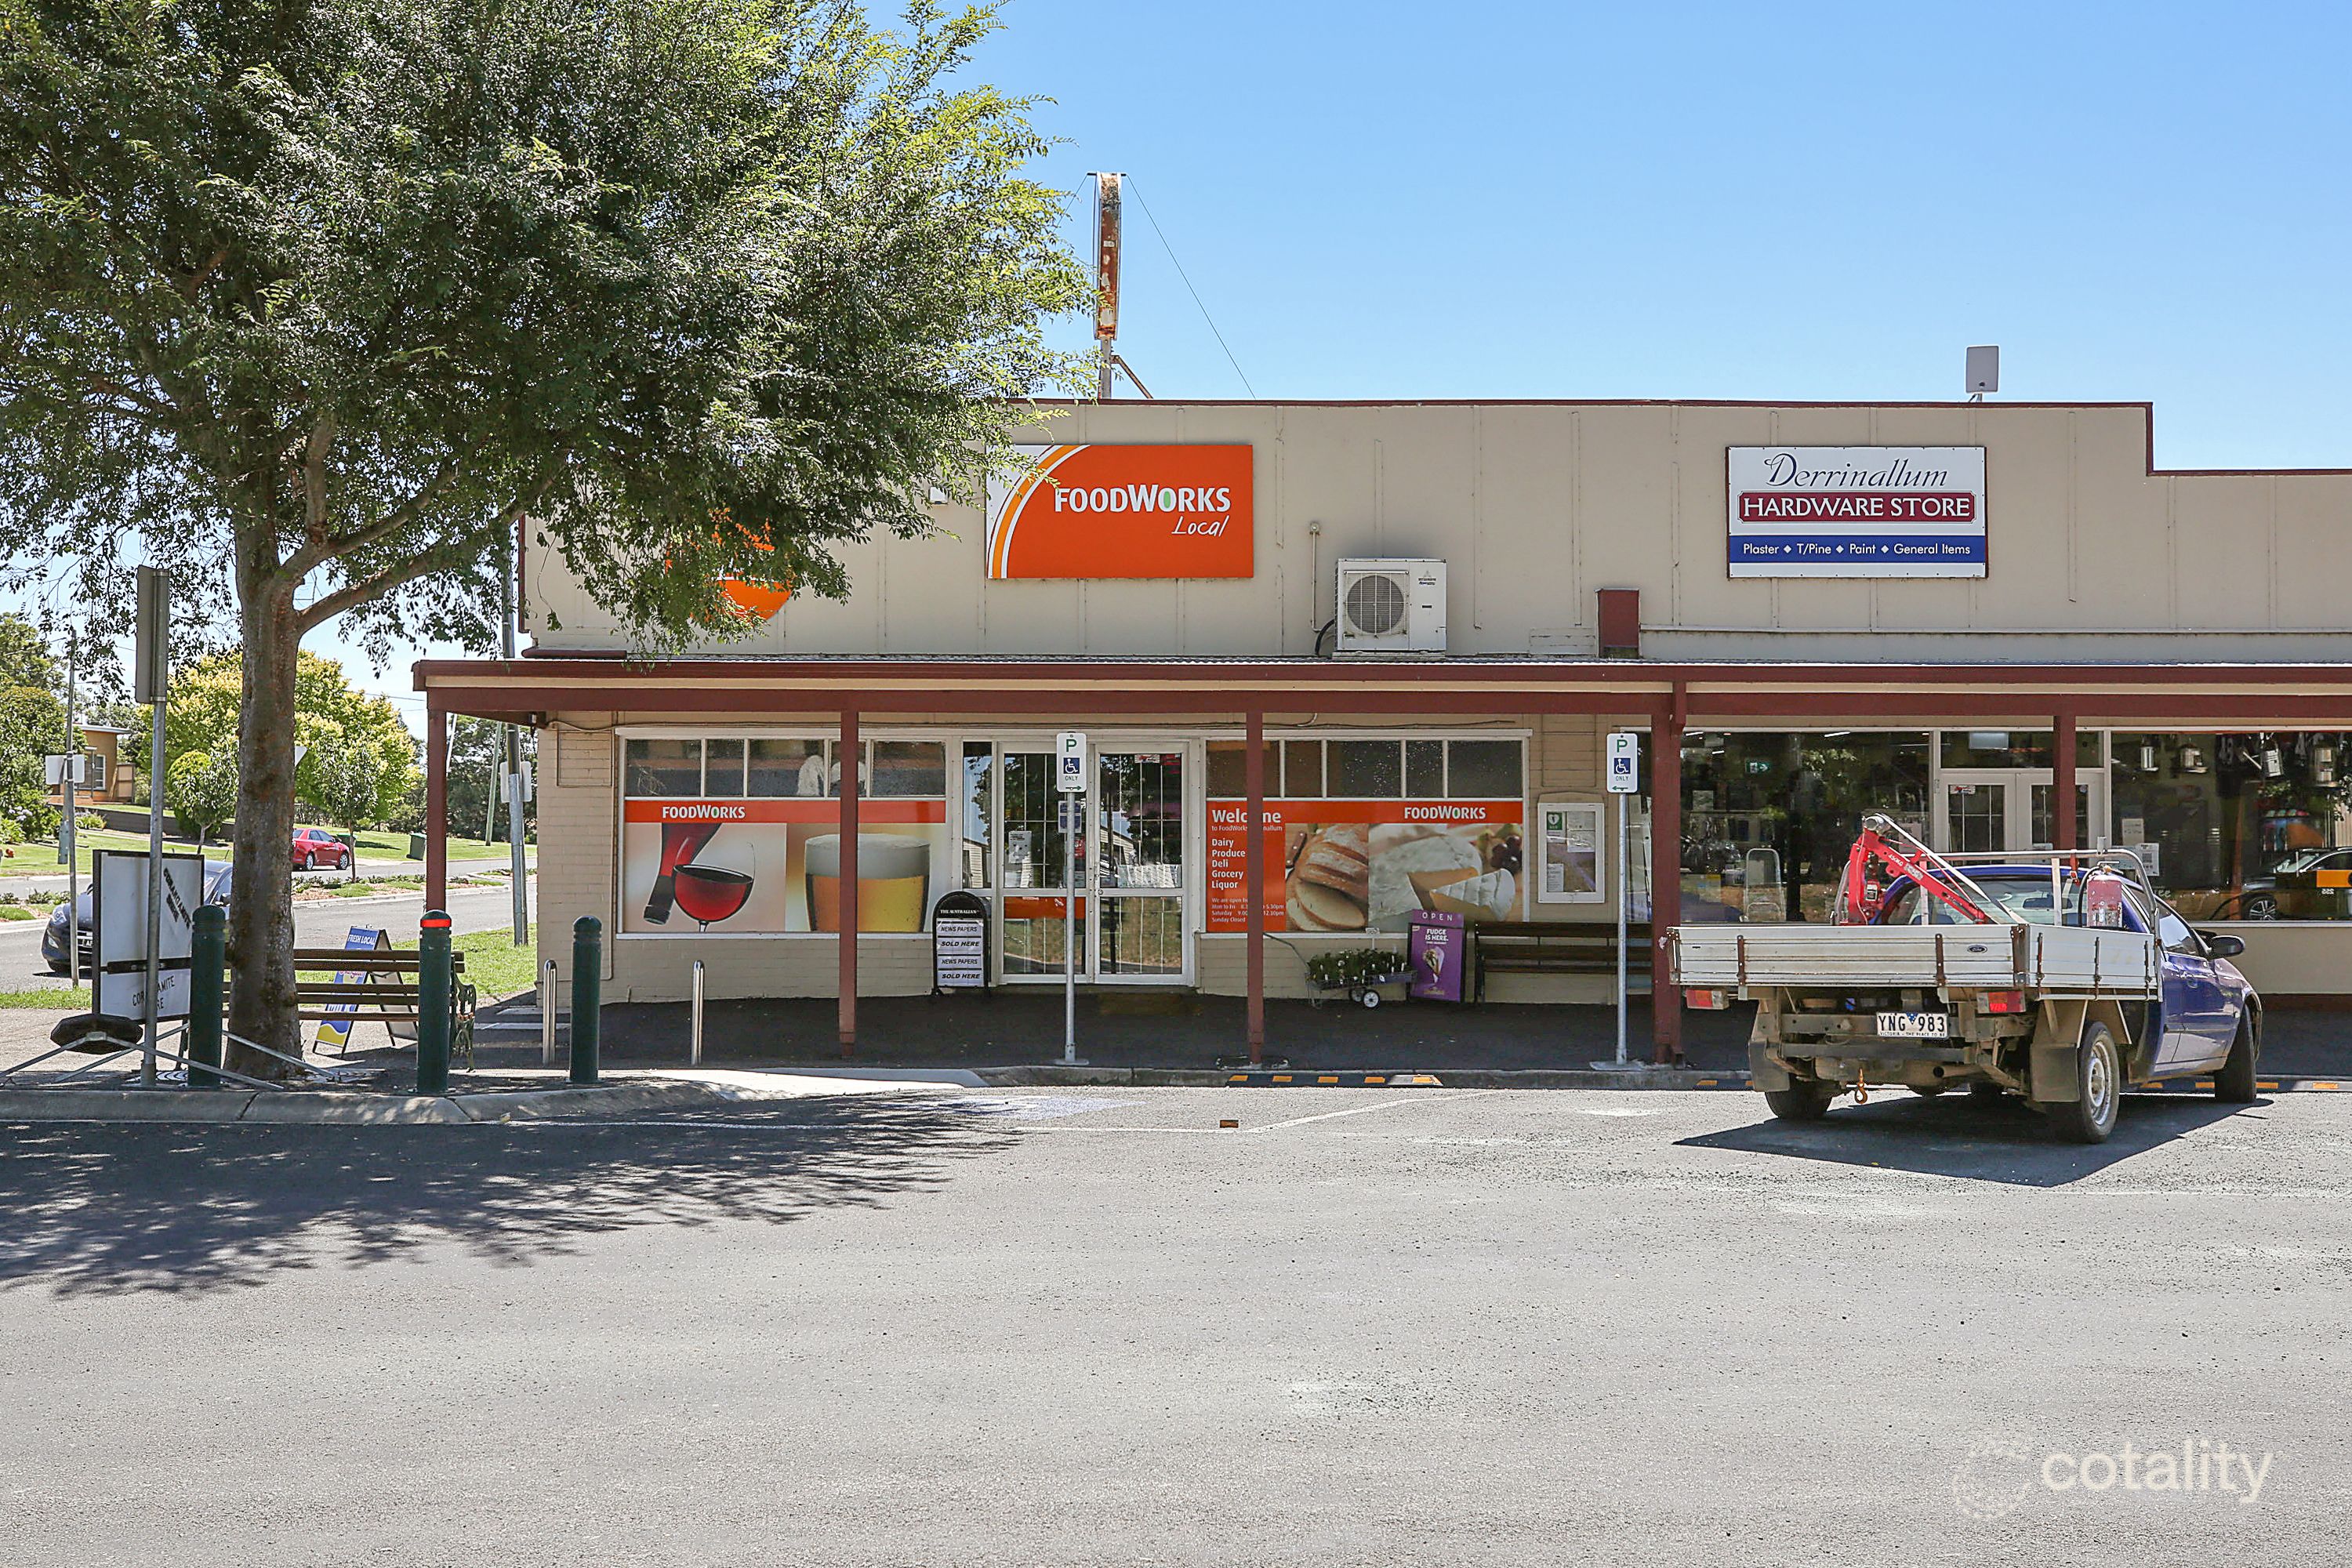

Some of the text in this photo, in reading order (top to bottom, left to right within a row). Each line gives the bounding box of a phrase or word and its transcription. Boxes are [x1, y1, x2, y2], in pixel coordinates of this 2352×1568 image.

[1763, 452, 1949, 488] Derrinallum
[1054, 484, 1231, 513] FOODWORKS
[1743, 497, 1970, 517] HARDWARE STORE
[1171, 514, 1230, 537] Local
[1743, 543, 1970, 555] Plaster T/Pine Paint General Items
[1065, 739, 1077, 753] P
[1617, 739, 1628, 753] P
[662, 804, 746, 818] FOODWORKS
[1211, 808, 1282, 823] Welcme
[1404, 805, 1486, 819] FOODWORKS
[1211, 837, 1234, 848] Dairy
[1211, 848, 1246, 857] Produce
[1211, 858, 1229, 868] Deli
[1211, 869, 1243, 880] Grocery
[1211, 880, 1239, 890] Liquor
[1422, 912, 1453, 922] OPEN
[347, 934, 376, 946] FRESH LOCAL
[1878, 1015, 1944, 1033] YNG 983
